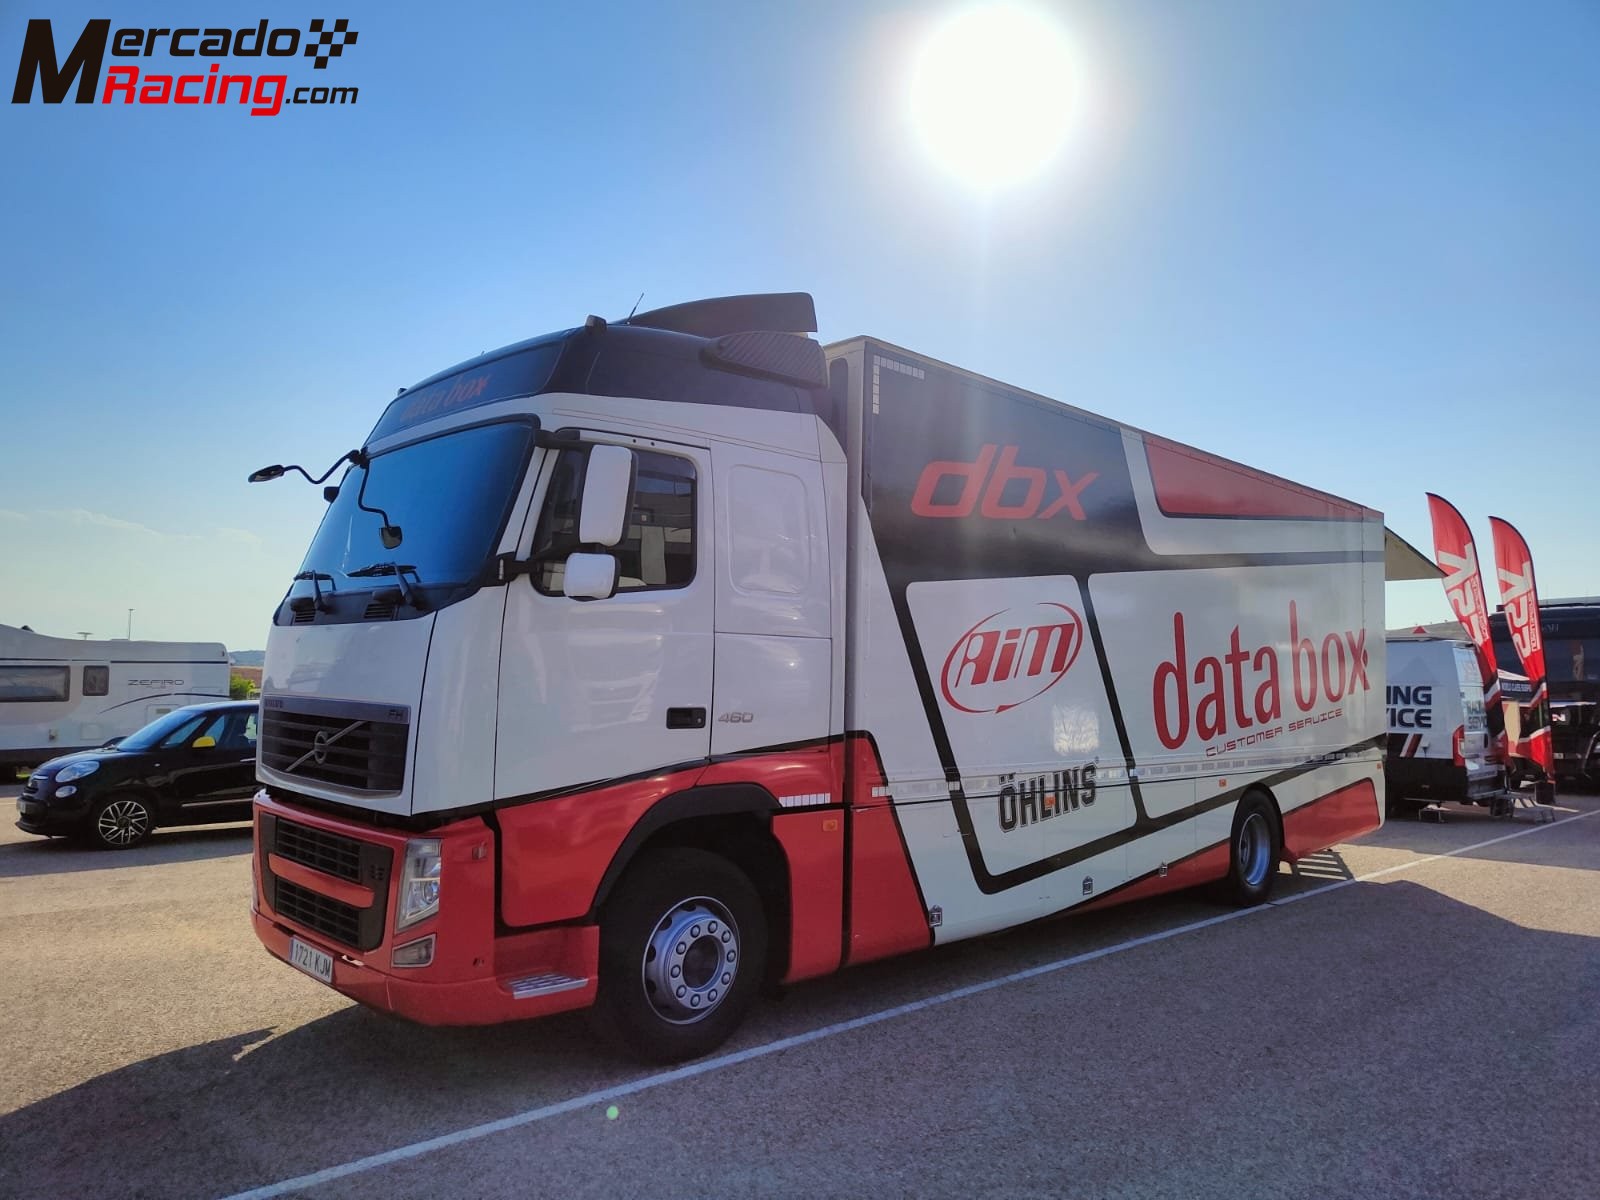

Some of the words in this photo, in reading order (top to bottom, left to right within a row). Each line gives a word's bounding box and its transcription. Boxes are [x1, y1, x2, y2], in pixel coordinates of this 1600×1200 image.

[910, 444, 1101, 521] dbx
[1153, 611, 1281, 750] data
[1289, 600, 1370, 712] box
[718, 712, 754, 723] 460
[1386, 708, 1432, 728] ICE
[1205, 726, 1283, 757] CUSTOMER
[999, 761, 1098, 833] ÖHLINS
[295, 943, 312, 968] 1721
[314, 953, 331, 978] KJM
